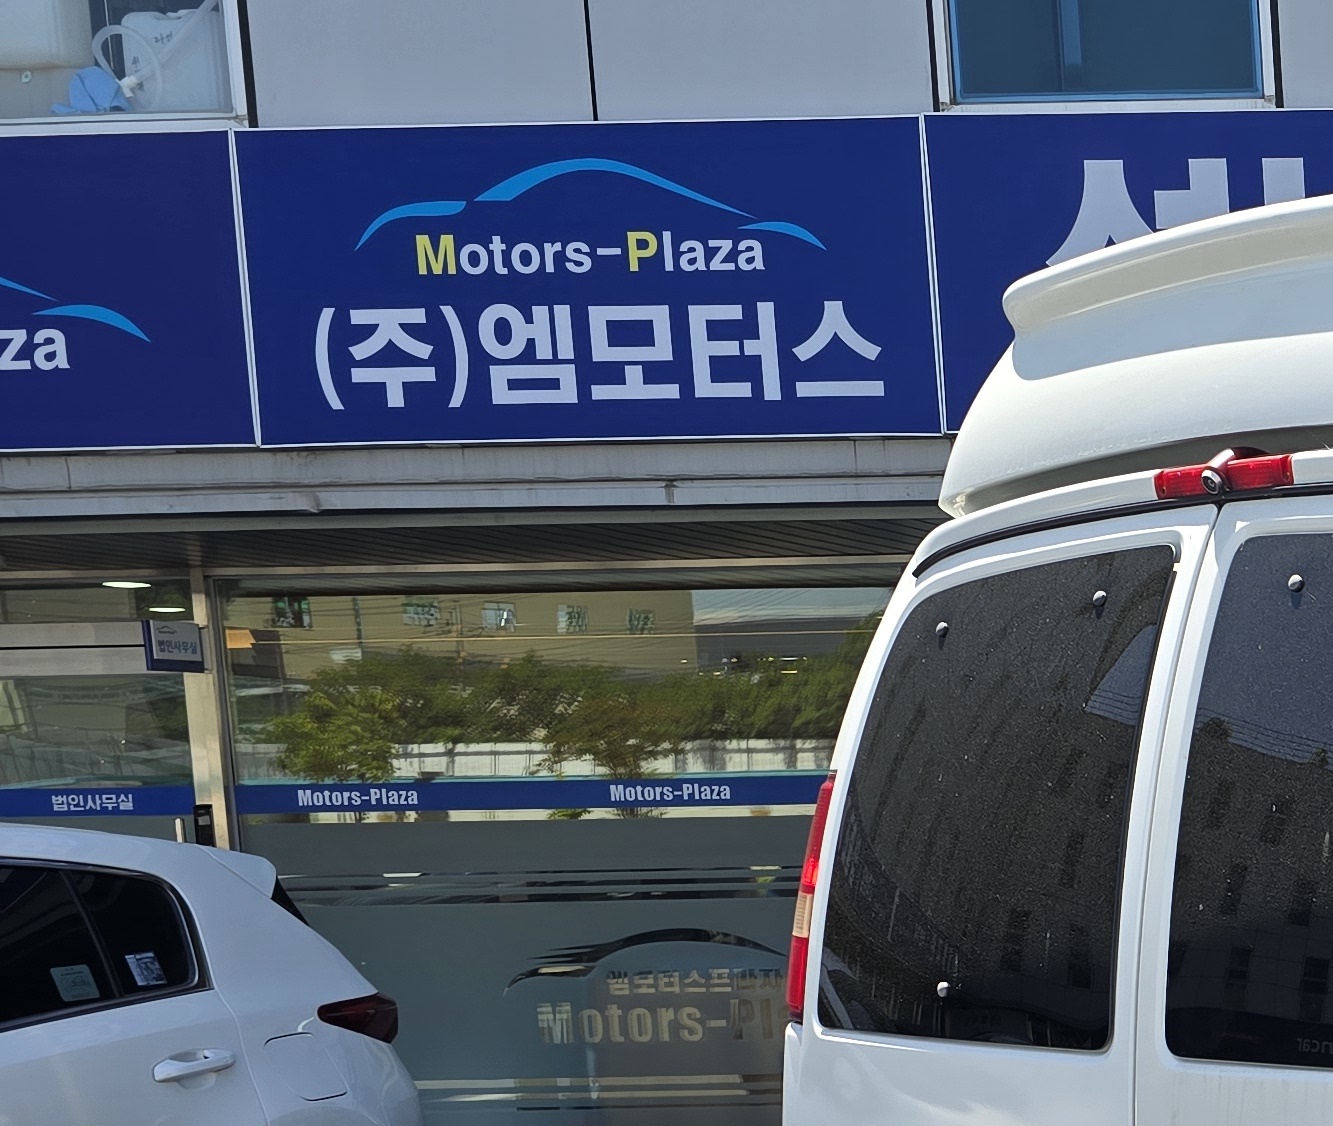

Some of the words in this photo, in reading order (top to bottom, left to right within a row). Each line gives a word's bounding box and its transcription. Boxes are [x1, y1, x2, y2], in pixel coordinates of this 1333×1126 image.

[416, 230, 765, 276] Motors-Plaza
[315, 300, 885, 410] (주)엠모터스
[157, 639, 198, 655] 법인사무실
[51, 793, 134, 811] 법인사무실
[297, 788, 419, 807] Motors-Plaza
[609, 783, 731, 803] Motors-Plaza
